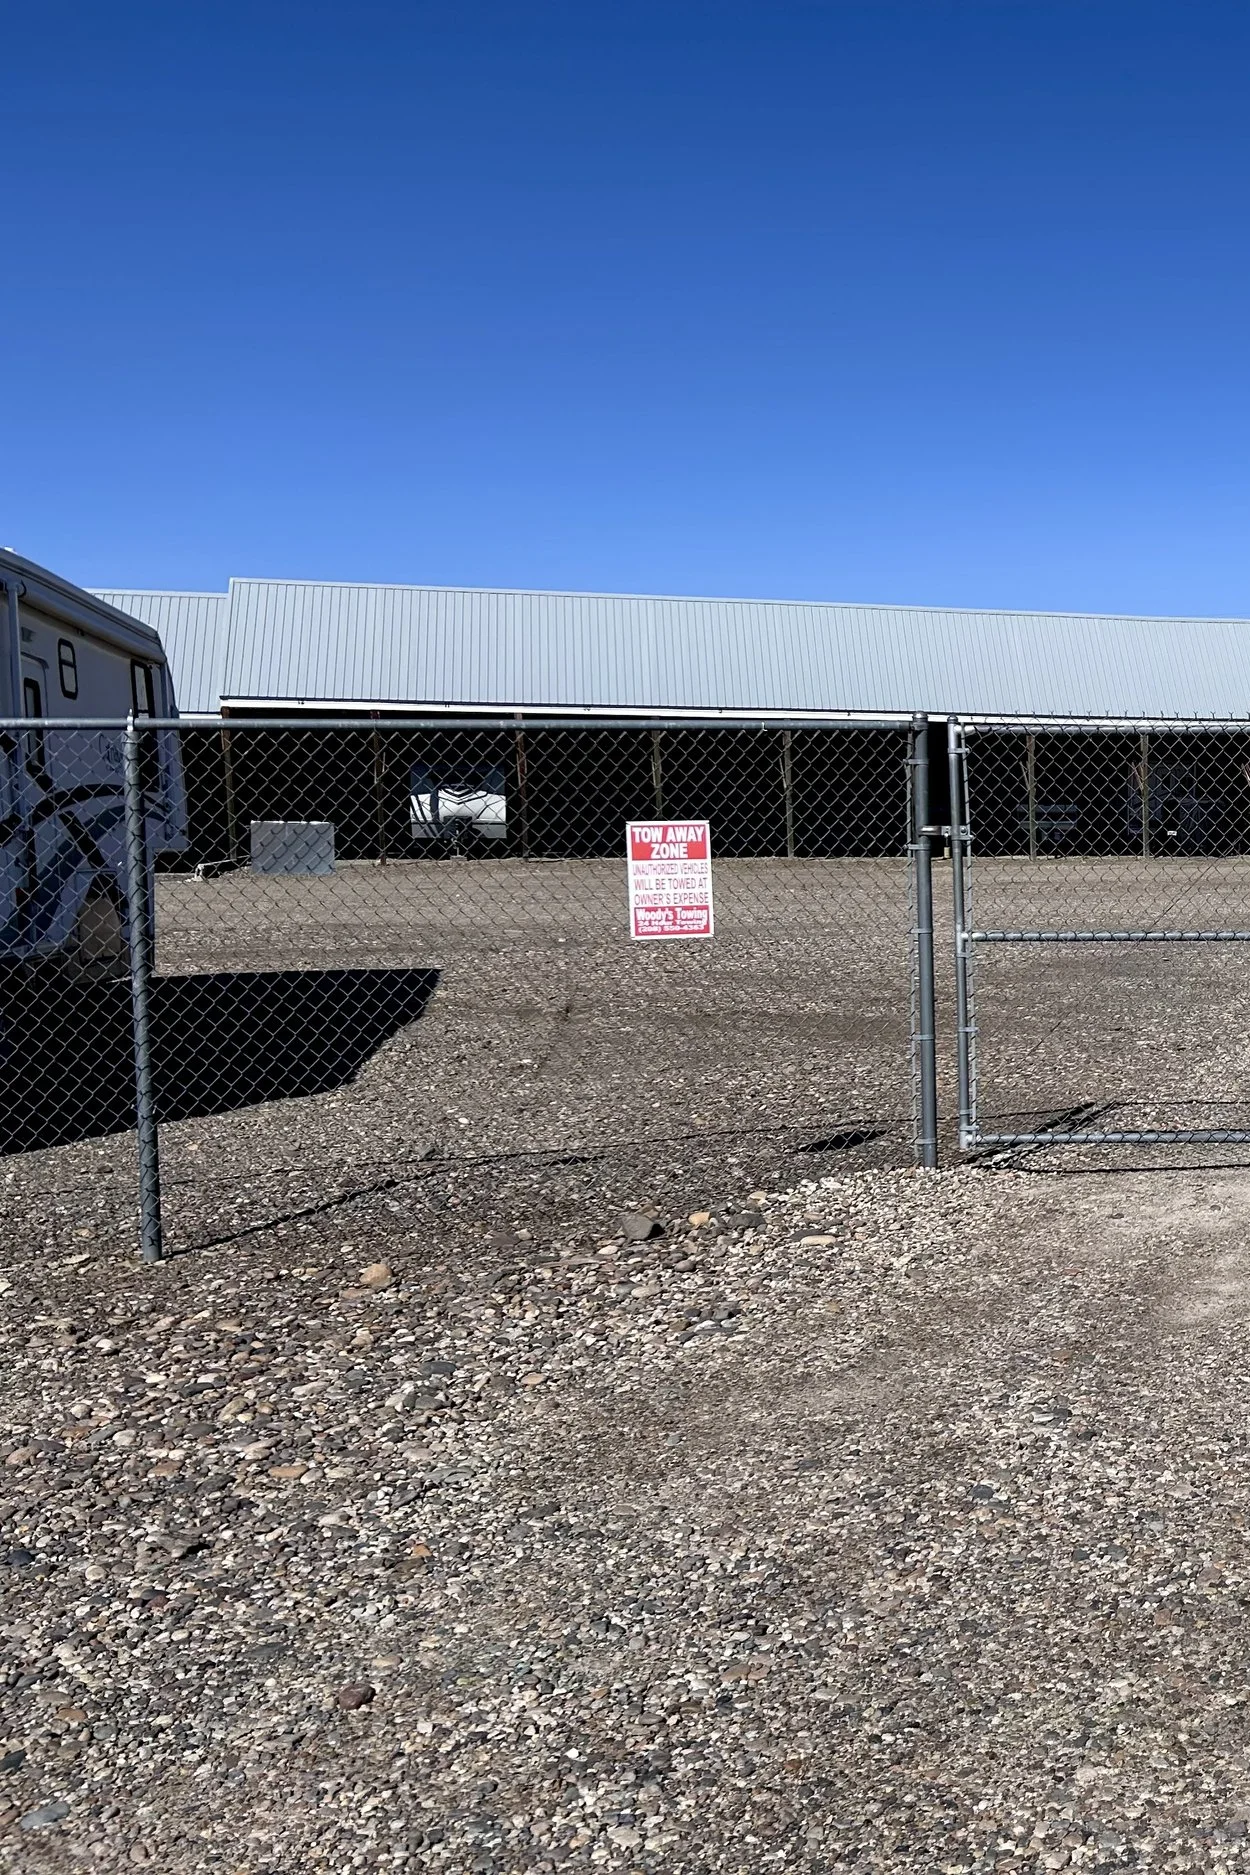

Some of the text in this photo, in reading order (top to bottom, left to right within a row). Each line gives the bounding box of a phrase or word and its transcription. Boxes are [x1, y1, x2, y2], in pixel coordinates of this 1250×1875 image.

[632, 826, 705, 842] TOW AWAY
[650, 843, 688, 859] ZONE
[632, 862, 708, 876] UNAUTHORIZED VEHICLES
[634, 877, 708, 891] WILL BE TOWED AT
[634, 892, 709, 906] OWNER'S EXPENSE
[636, 906, 708, 921] Woody's Towing
